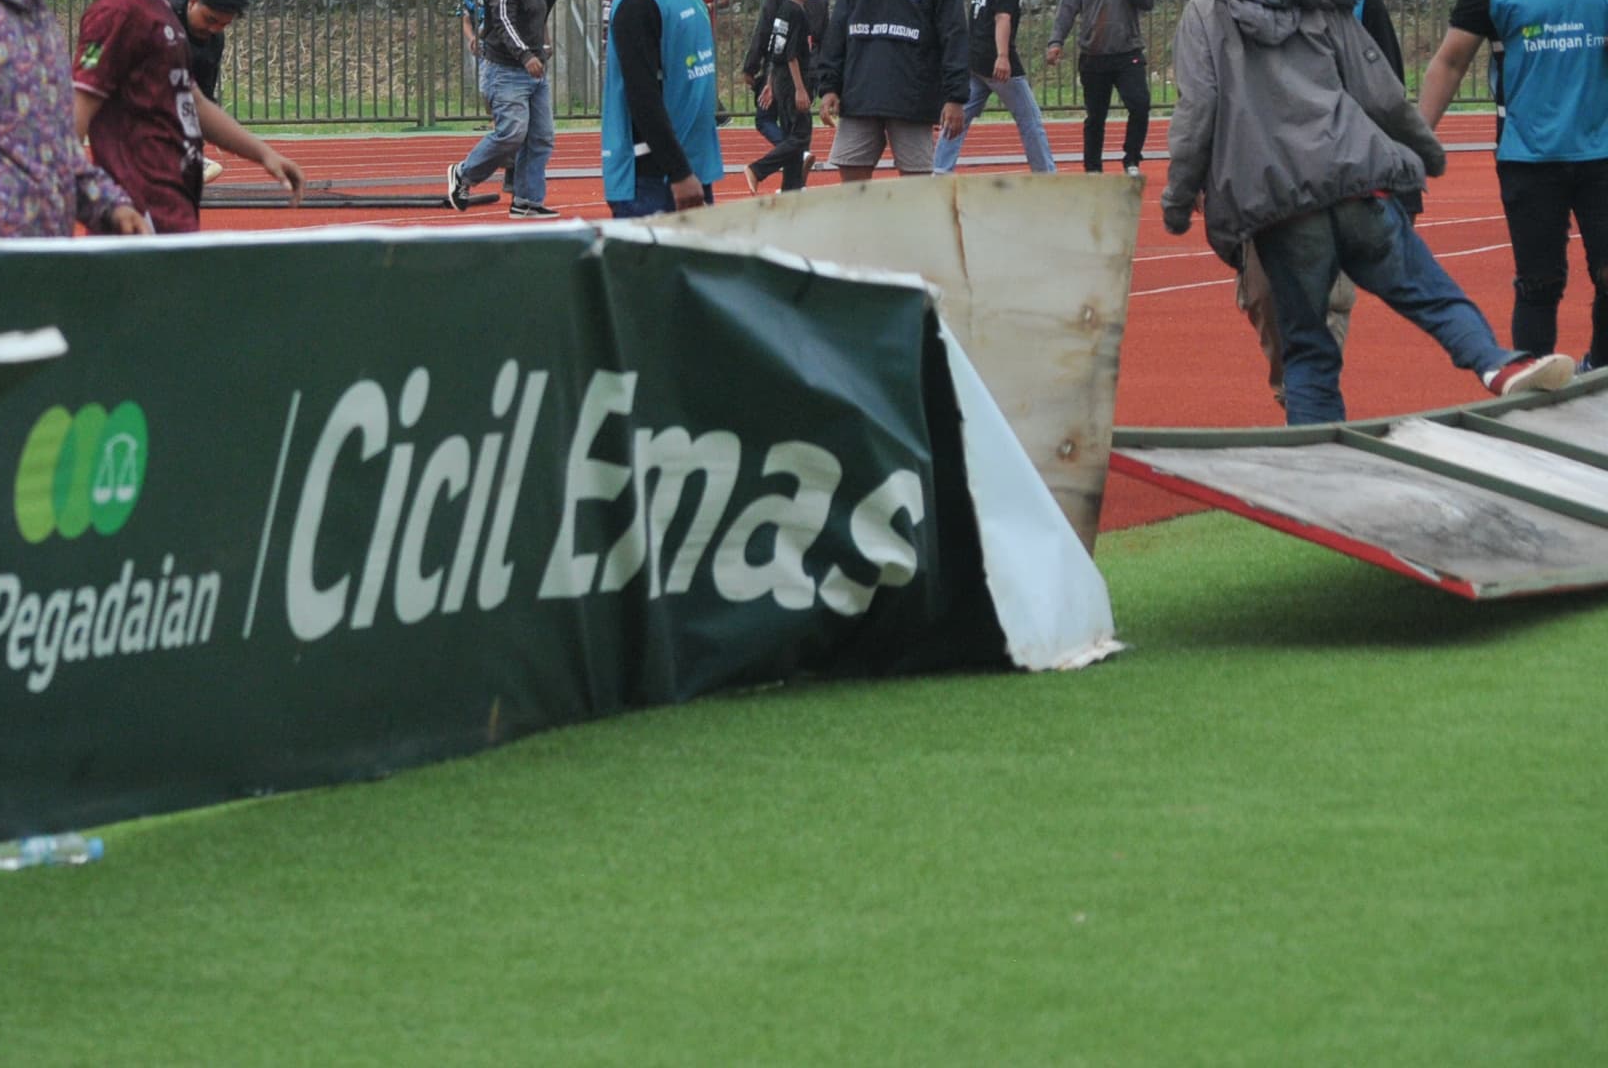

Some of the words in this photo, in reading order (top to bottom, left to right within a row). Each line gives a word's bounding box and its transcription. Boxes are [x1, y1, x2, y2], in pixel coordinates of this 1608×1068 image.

[1586, 33, 1608, 48] Em
[286, 358, 549, 642] Cicil
[537, 369, 925, 616] Emas
